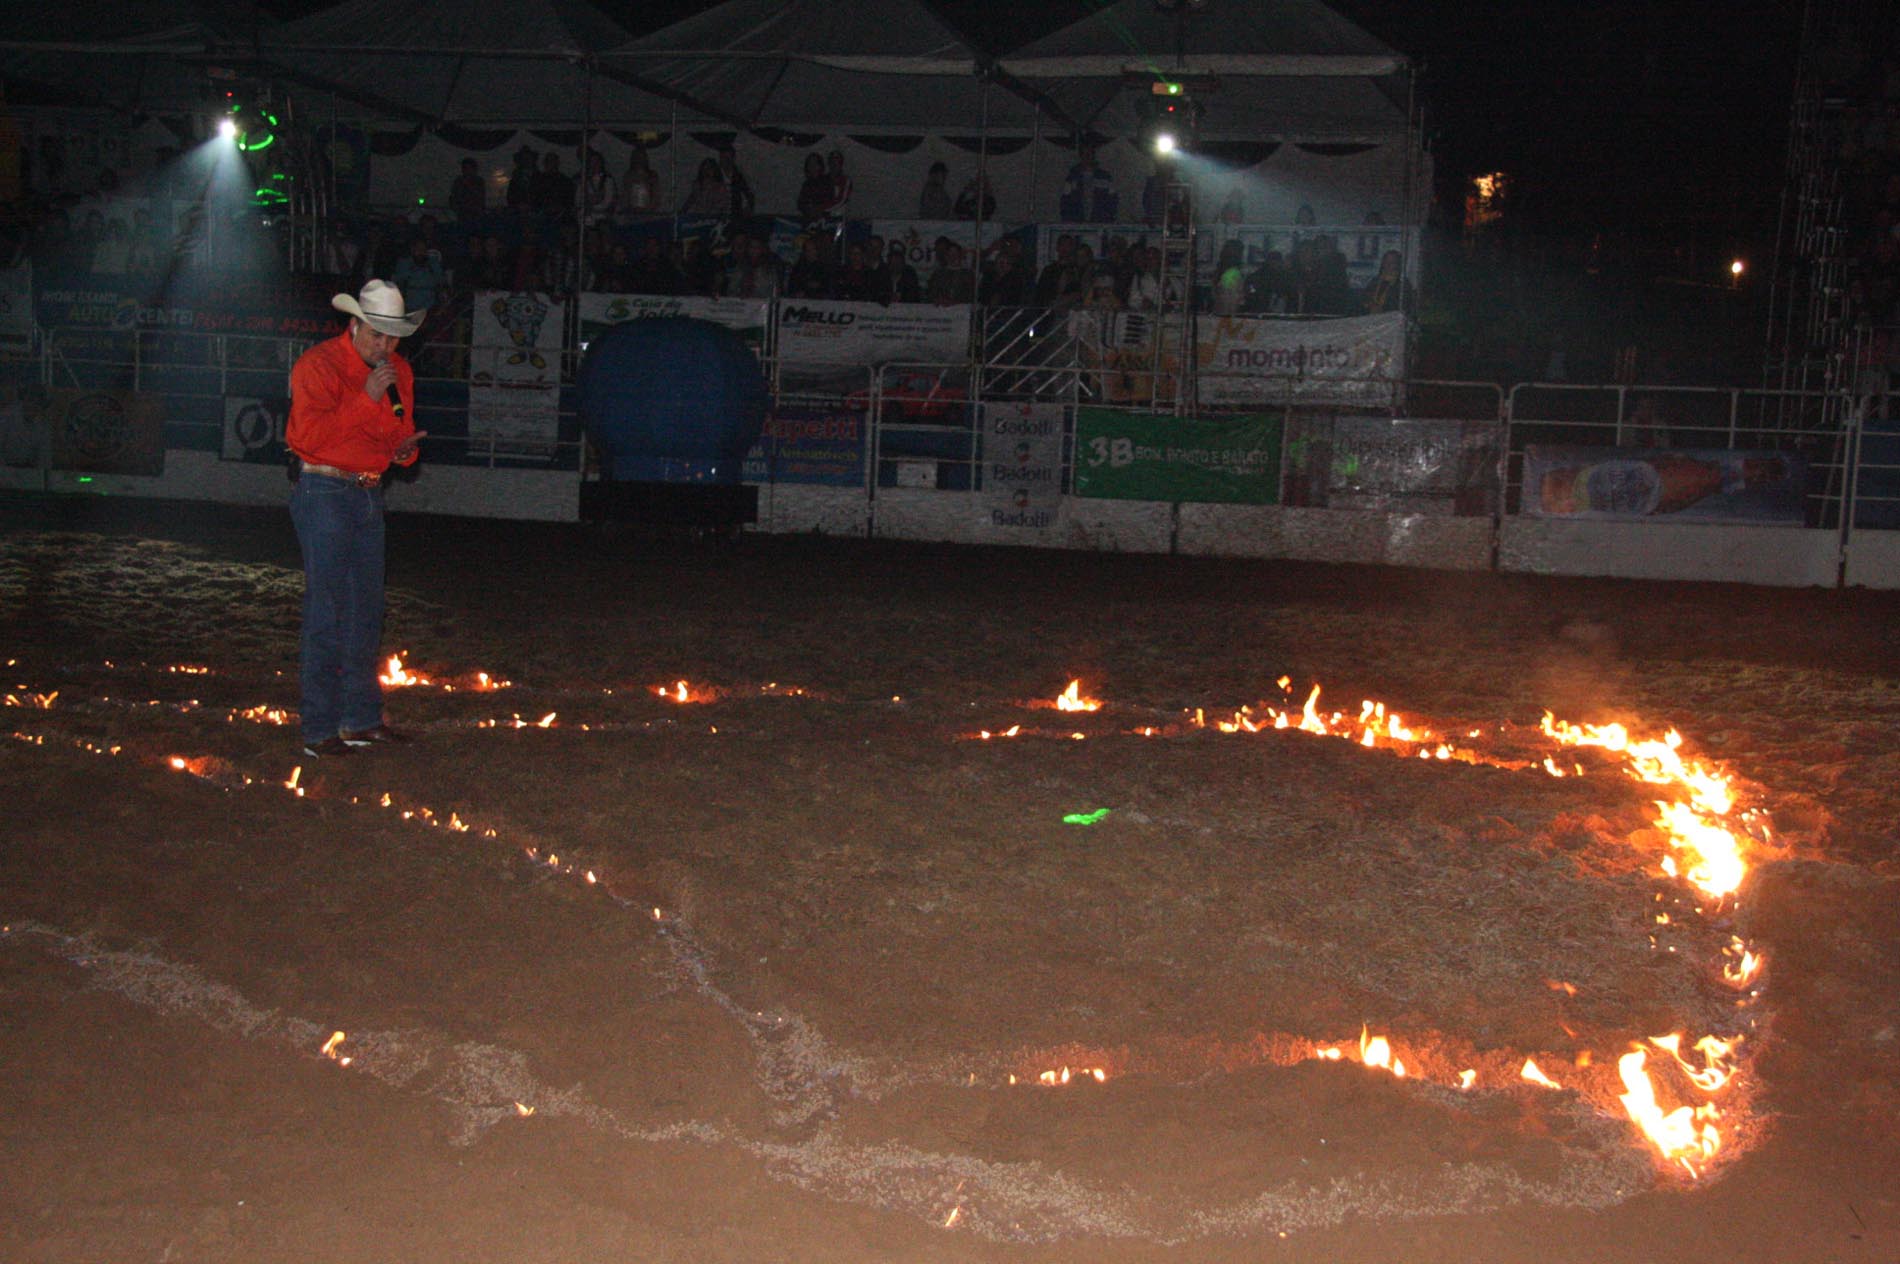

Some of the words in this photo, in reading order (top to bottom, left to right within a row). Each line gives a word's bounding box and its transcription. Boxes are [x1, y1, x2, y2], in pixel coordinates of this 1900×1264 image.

[1228, 344, 1349, 369] momento
[994, 416, 1053, 436] Badotti
[1087, 436, 1135, 467] 3B
[993, 463, 1052, 482] Badotti
[992, 509, 1050, 528] Badotti
